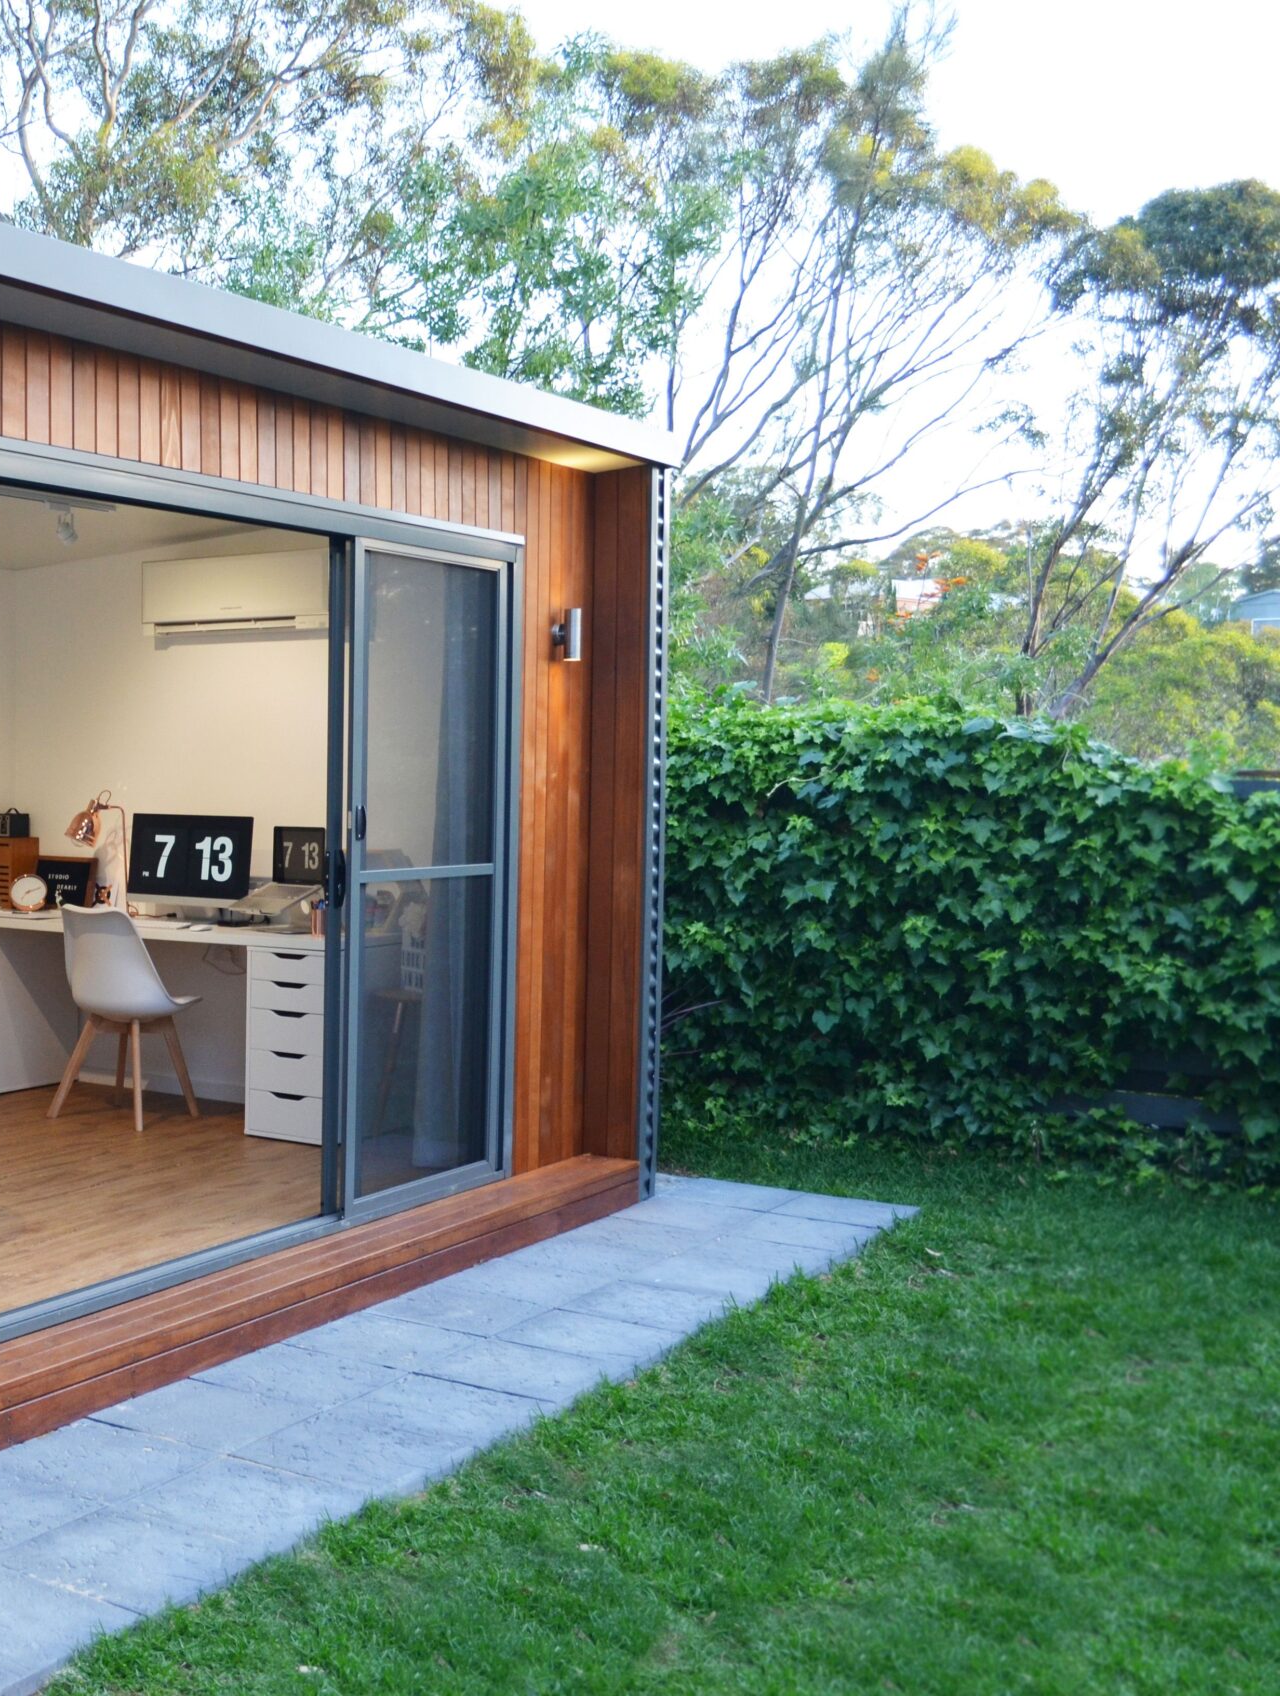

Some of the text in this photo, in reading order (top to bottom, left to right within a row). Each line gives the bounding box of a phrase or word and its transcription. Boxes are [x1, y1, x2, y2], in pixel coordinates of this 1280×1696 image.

[155, 834, 233, 882] 7 13
[283, 842, 319, 870] 7 13
